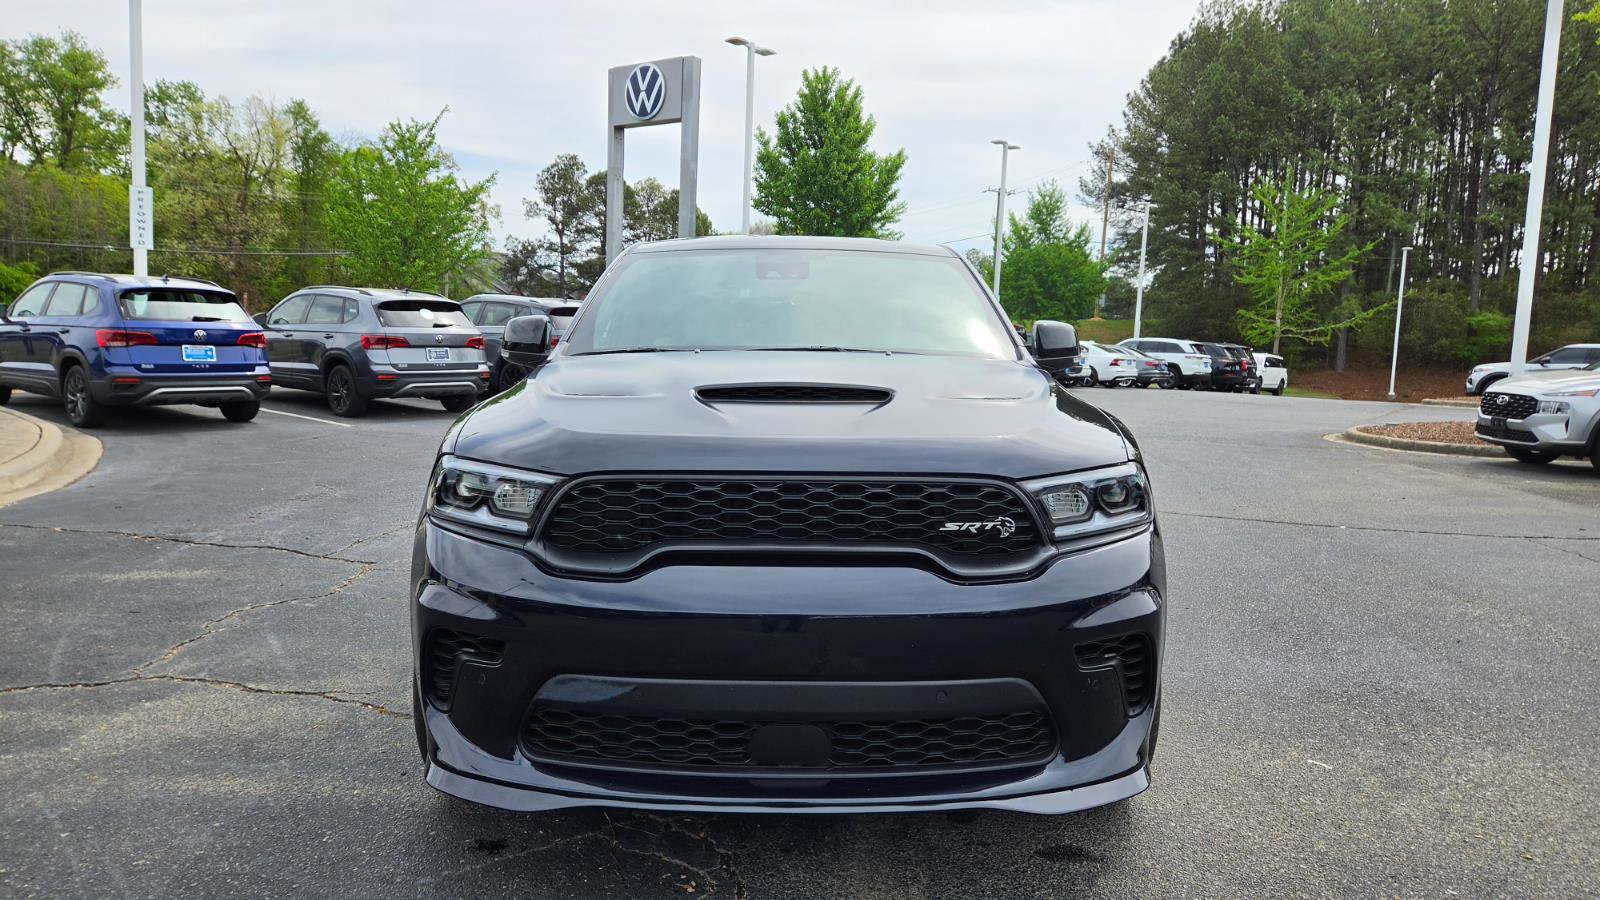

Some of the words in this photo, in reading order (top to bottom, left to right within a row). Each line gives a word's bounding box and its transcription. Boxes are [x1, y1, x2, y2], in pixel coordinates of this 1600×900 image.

[626, 64, 664, 117] VW
[136, 190, 146, 245] PREOWNED
[938, 521, 1002, 534] SRT
